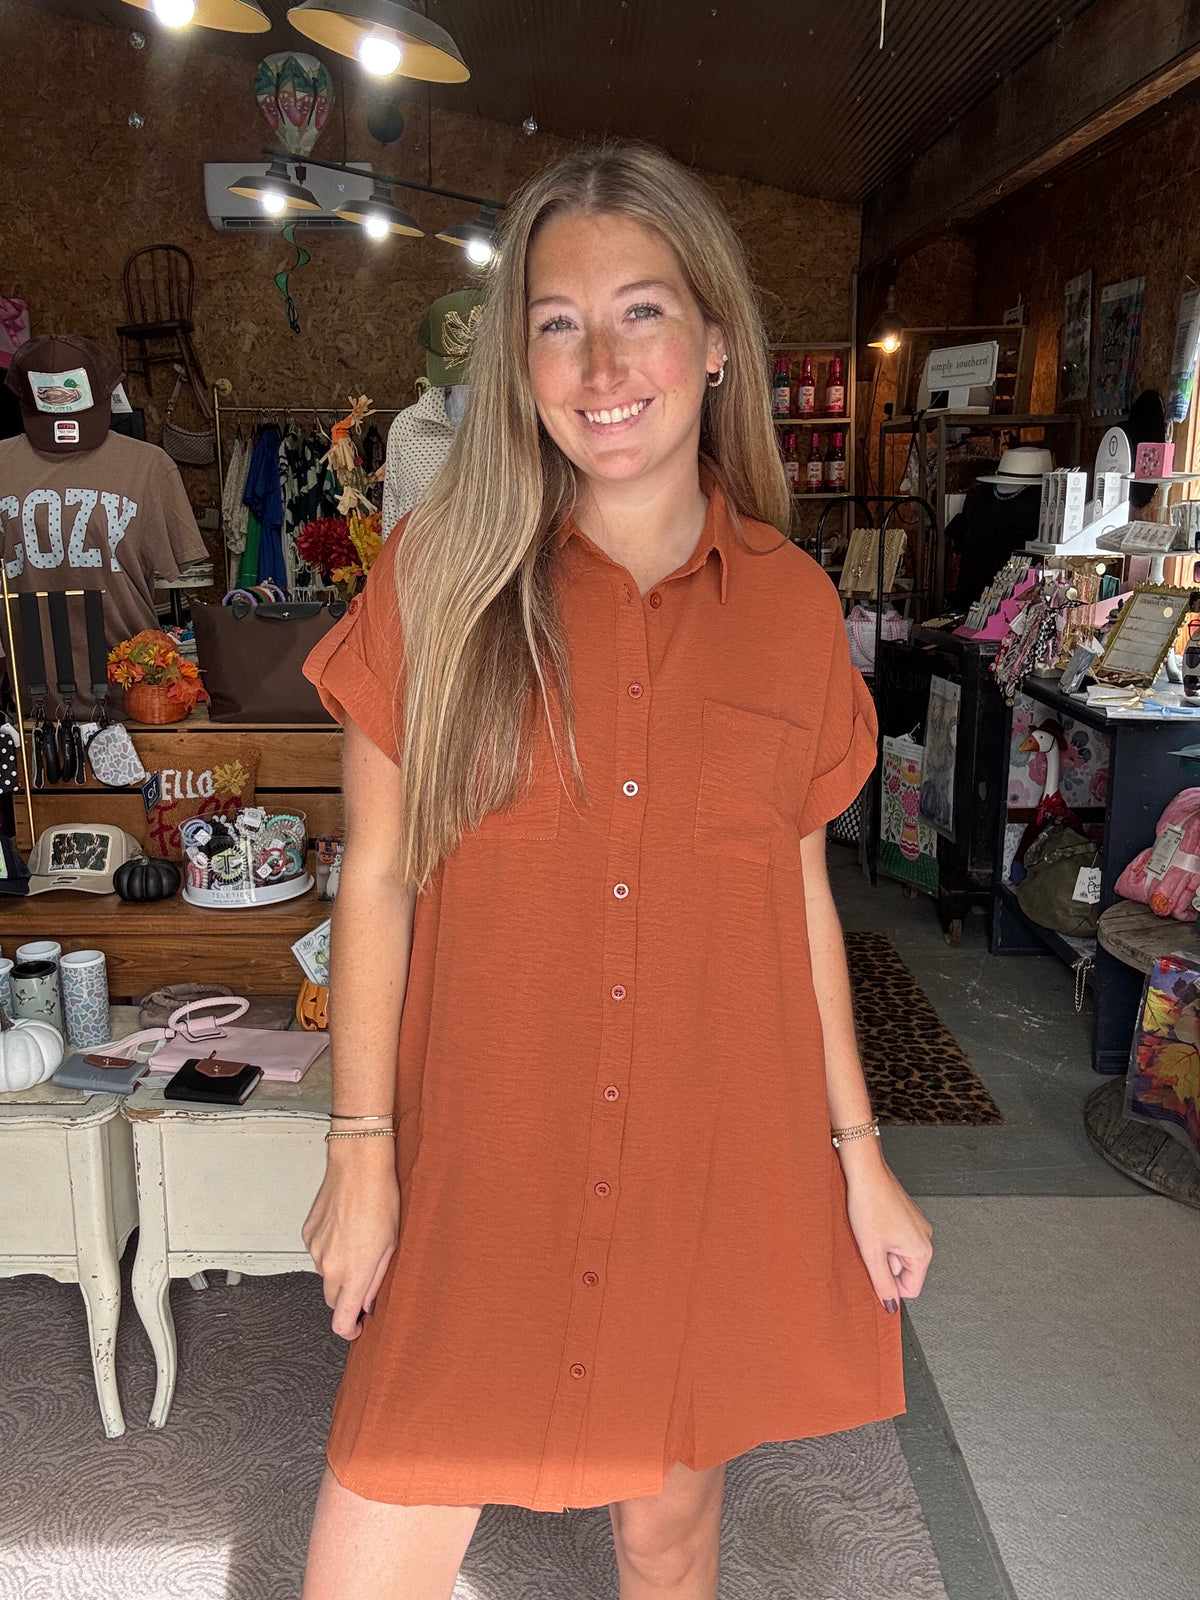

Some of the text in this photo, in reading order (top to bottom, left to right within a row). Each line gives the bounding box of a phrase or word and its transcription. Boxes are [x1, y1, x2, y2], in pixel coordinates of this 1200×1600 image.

[931, 355, 988, 374] simply southern
[0, 488, 137, 579] COZY
